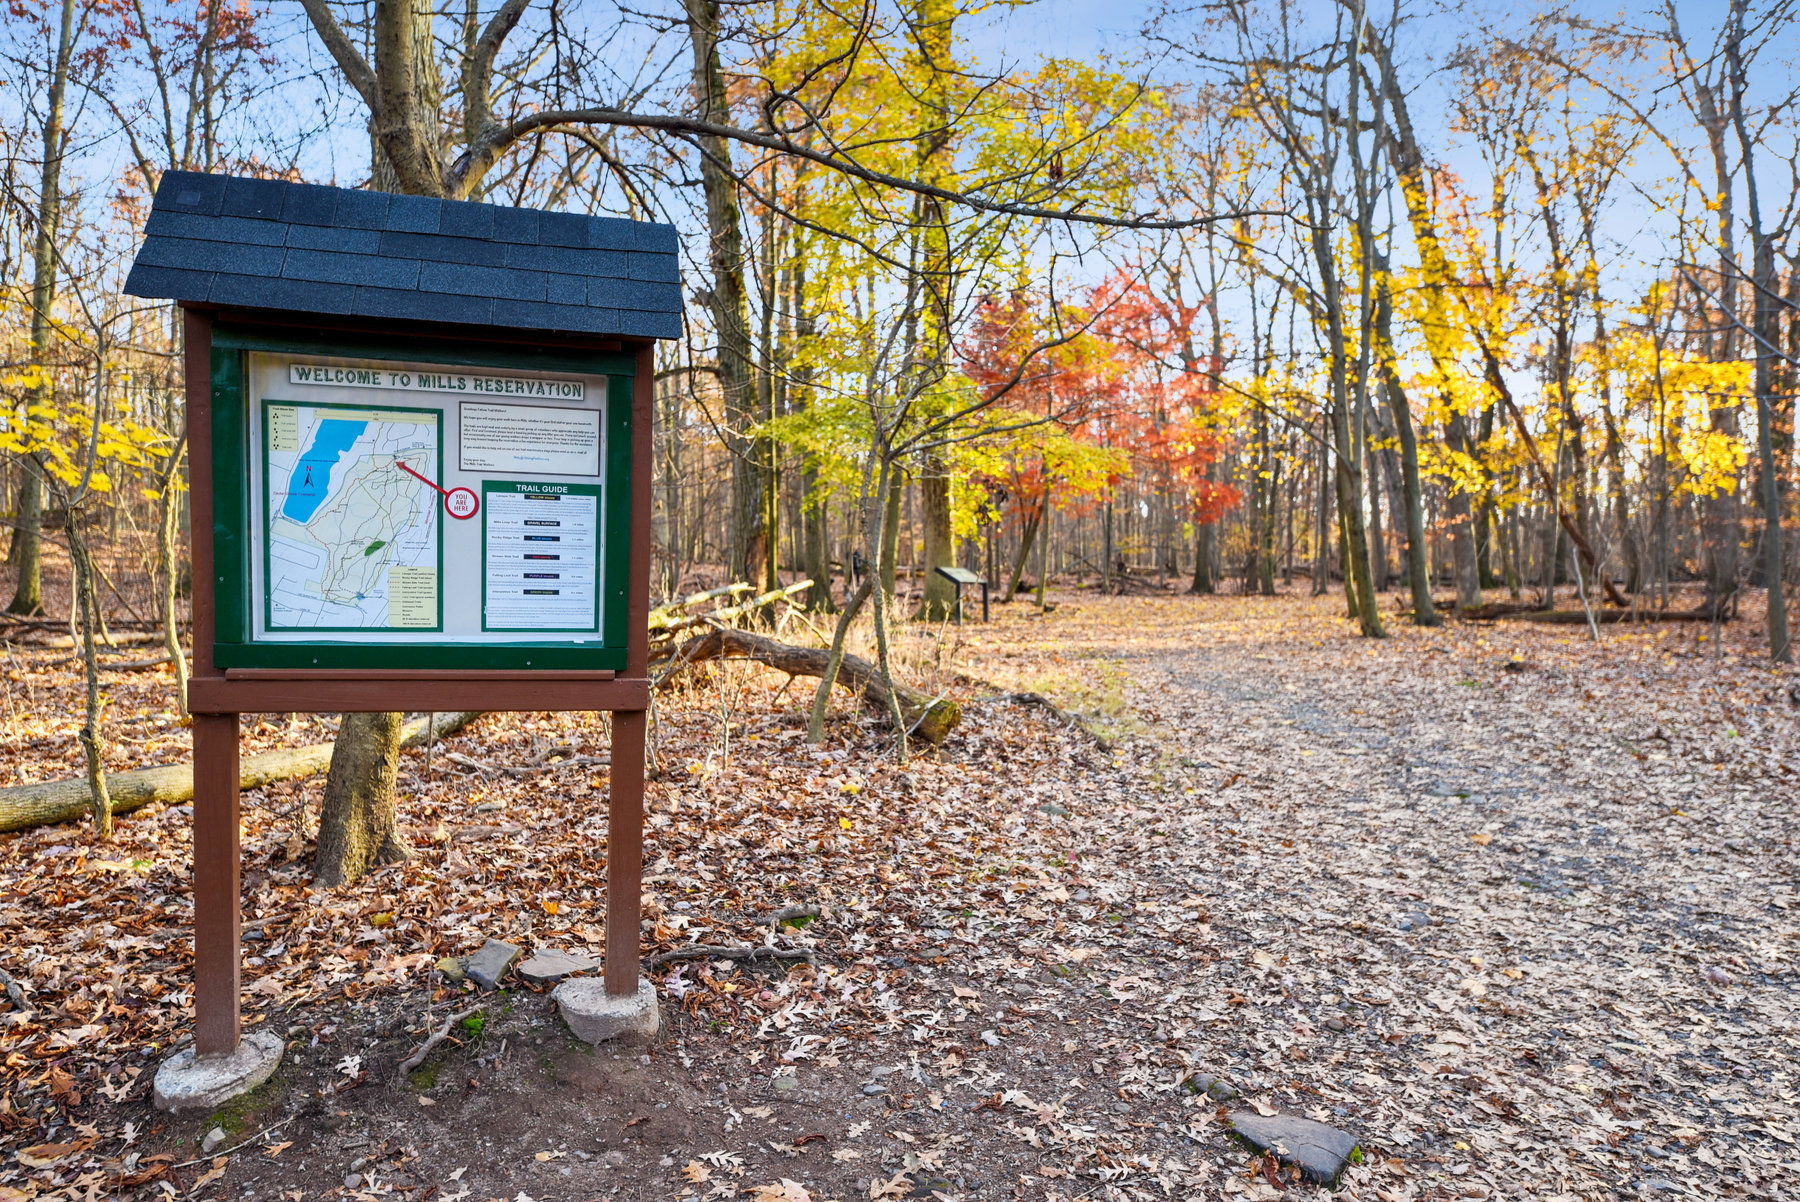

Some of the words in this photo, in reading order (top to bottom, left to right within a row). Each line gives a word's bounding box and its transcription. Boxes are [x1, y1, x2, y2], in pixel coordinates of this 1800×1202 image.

[294, 367, 382, 386] WELCOME
[388, 372, 411, 387] TO
[418, 374, 467, 390] MILLS
[473, 377, 582, 397] RESERVATION
[516, 484, 540, 492] TRAIL
[542, 485, 568, 493] GUIDE
